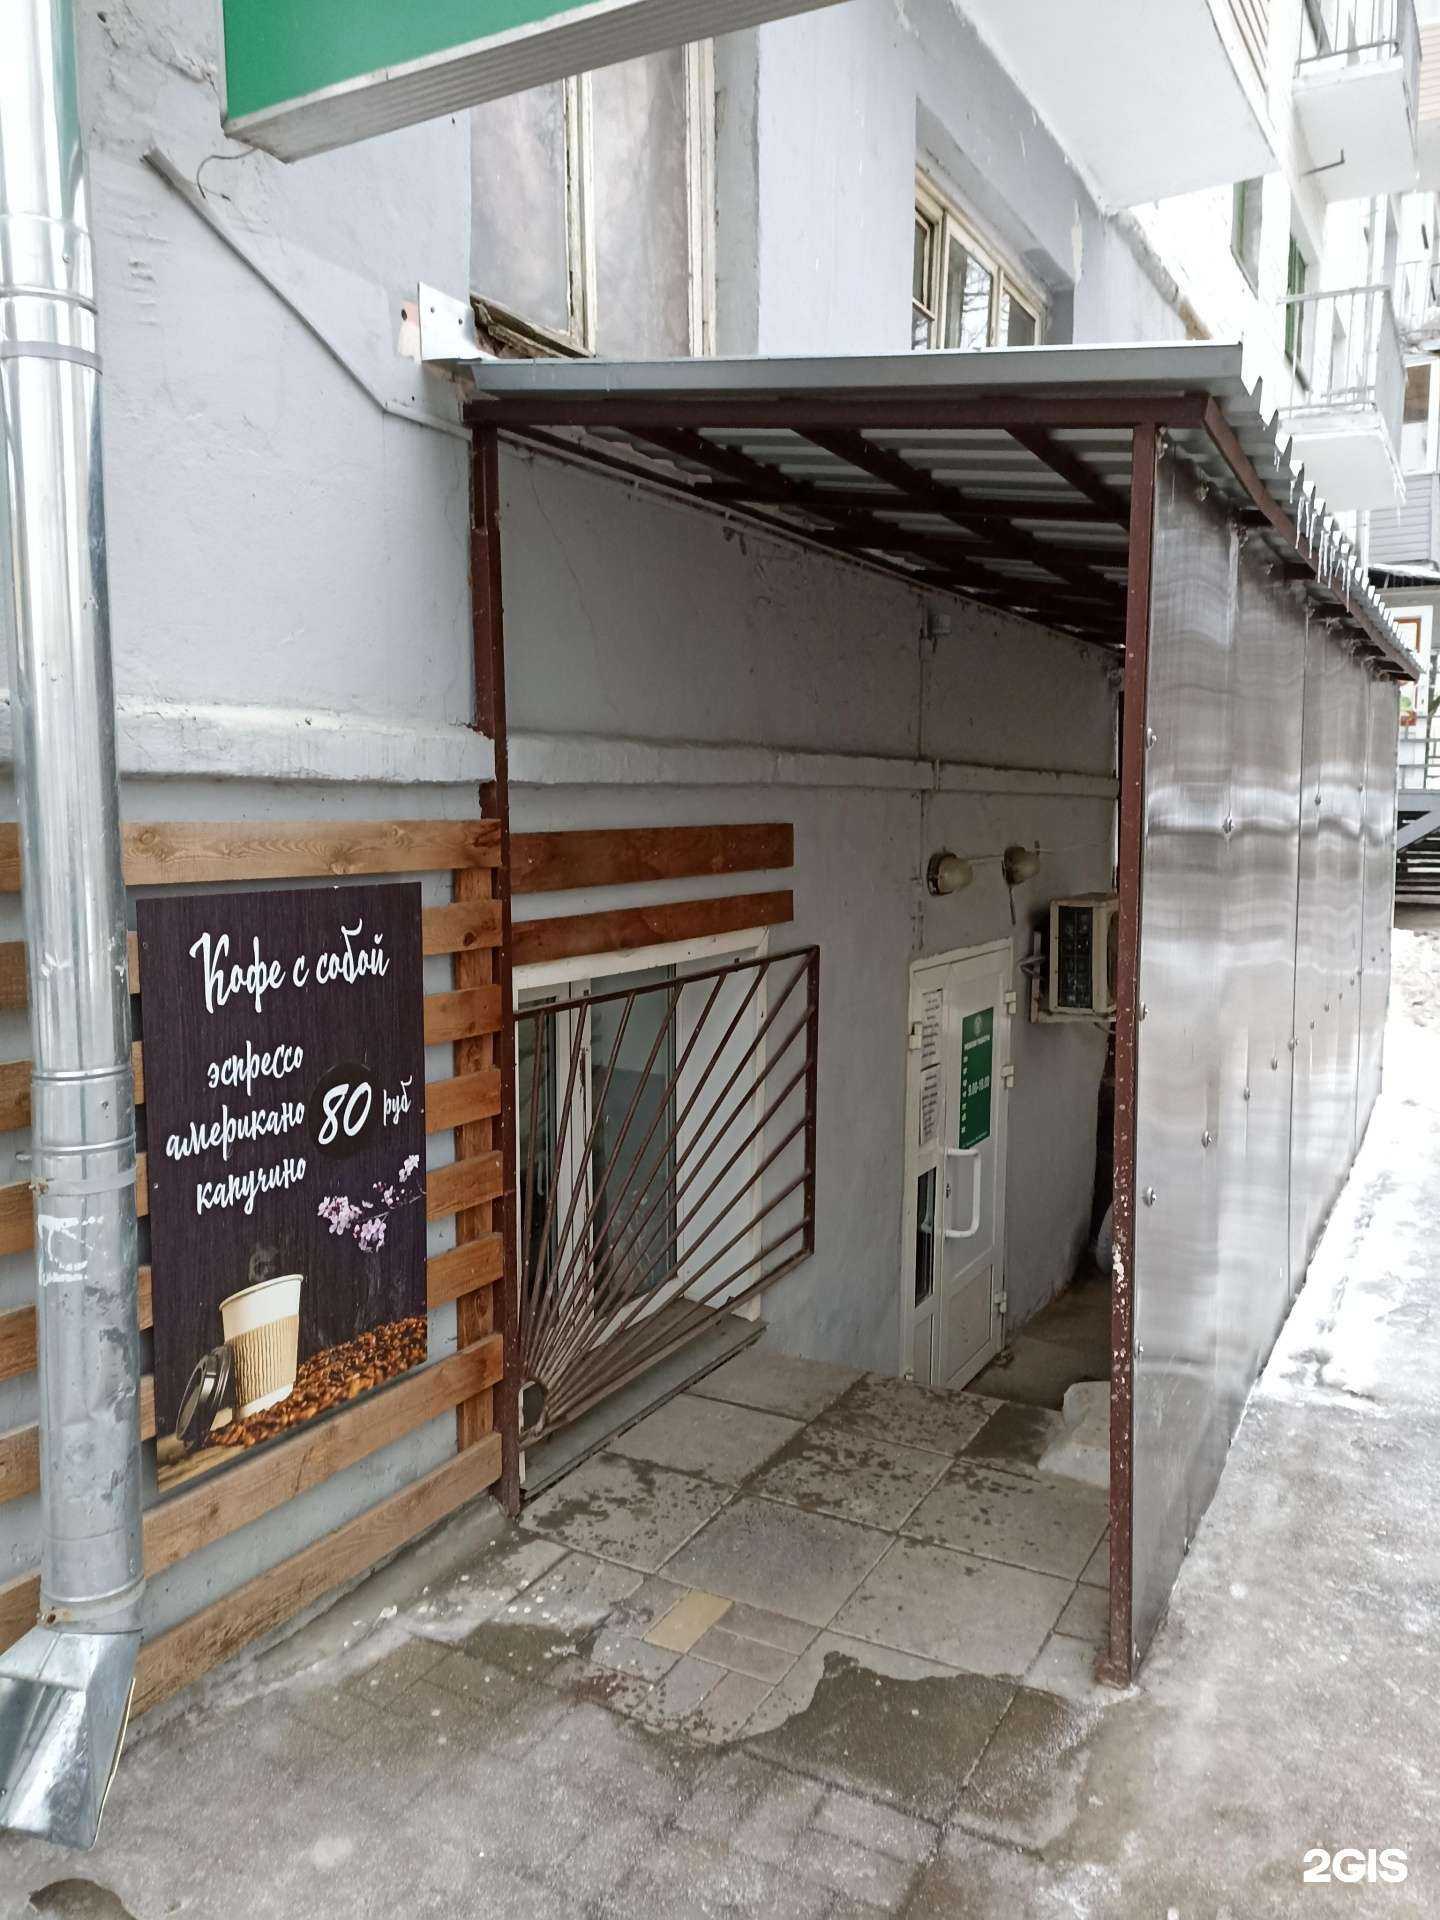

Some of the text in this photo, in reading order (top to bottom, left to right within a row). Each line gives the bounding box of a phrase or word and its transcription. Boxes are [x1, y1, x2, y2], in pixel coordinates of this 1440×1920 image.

[190, 919, 390, 1013] Кофе с собой
[208, 1041, 304, 1096] эспрессо
[166, 1102, 305, 1161] американо
[317, 1076, 412, 1145] 80 руб
[196, 1157, 306, 1214] капучино
